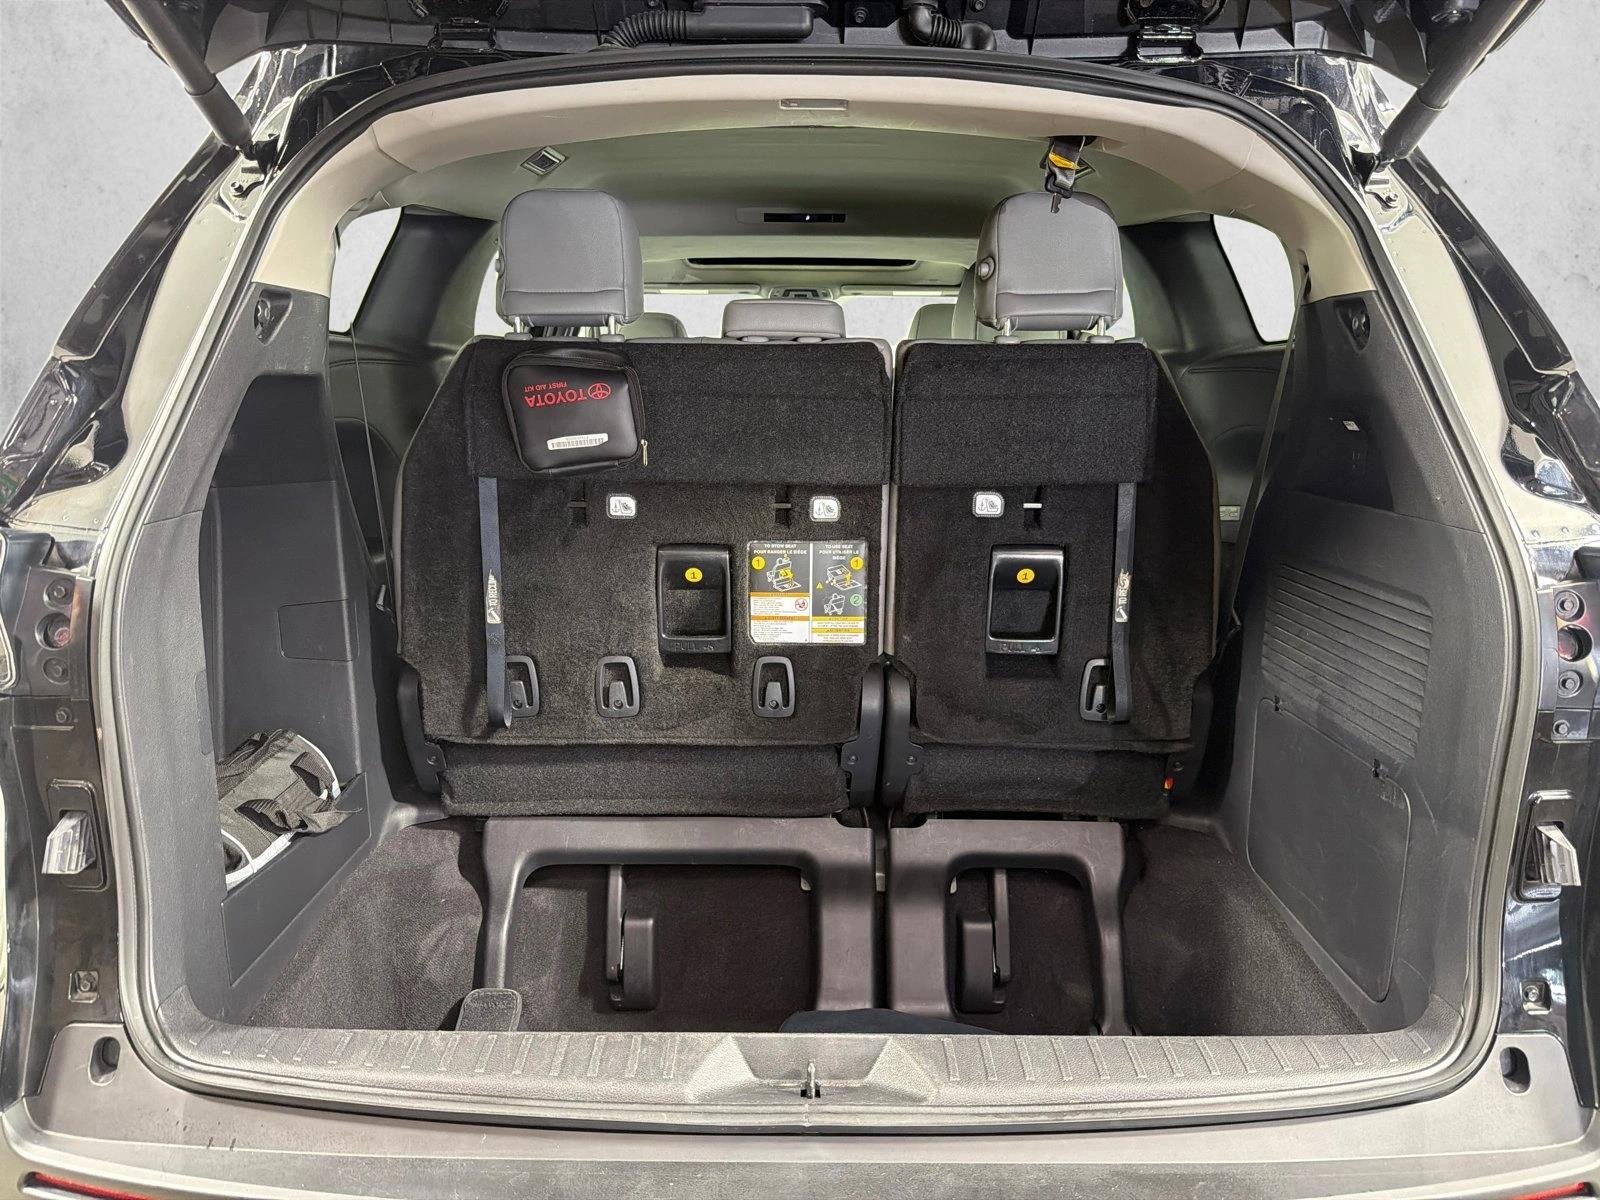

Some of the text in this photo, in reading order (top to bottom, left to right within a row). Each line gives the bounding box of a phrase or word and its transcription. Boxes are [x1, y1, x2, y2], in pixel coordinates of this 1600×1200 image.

[524, 389, 587, 407] TOYOTA
[489, 599, 497, 607] TO
[1119, 597, 1127, 605] TO
